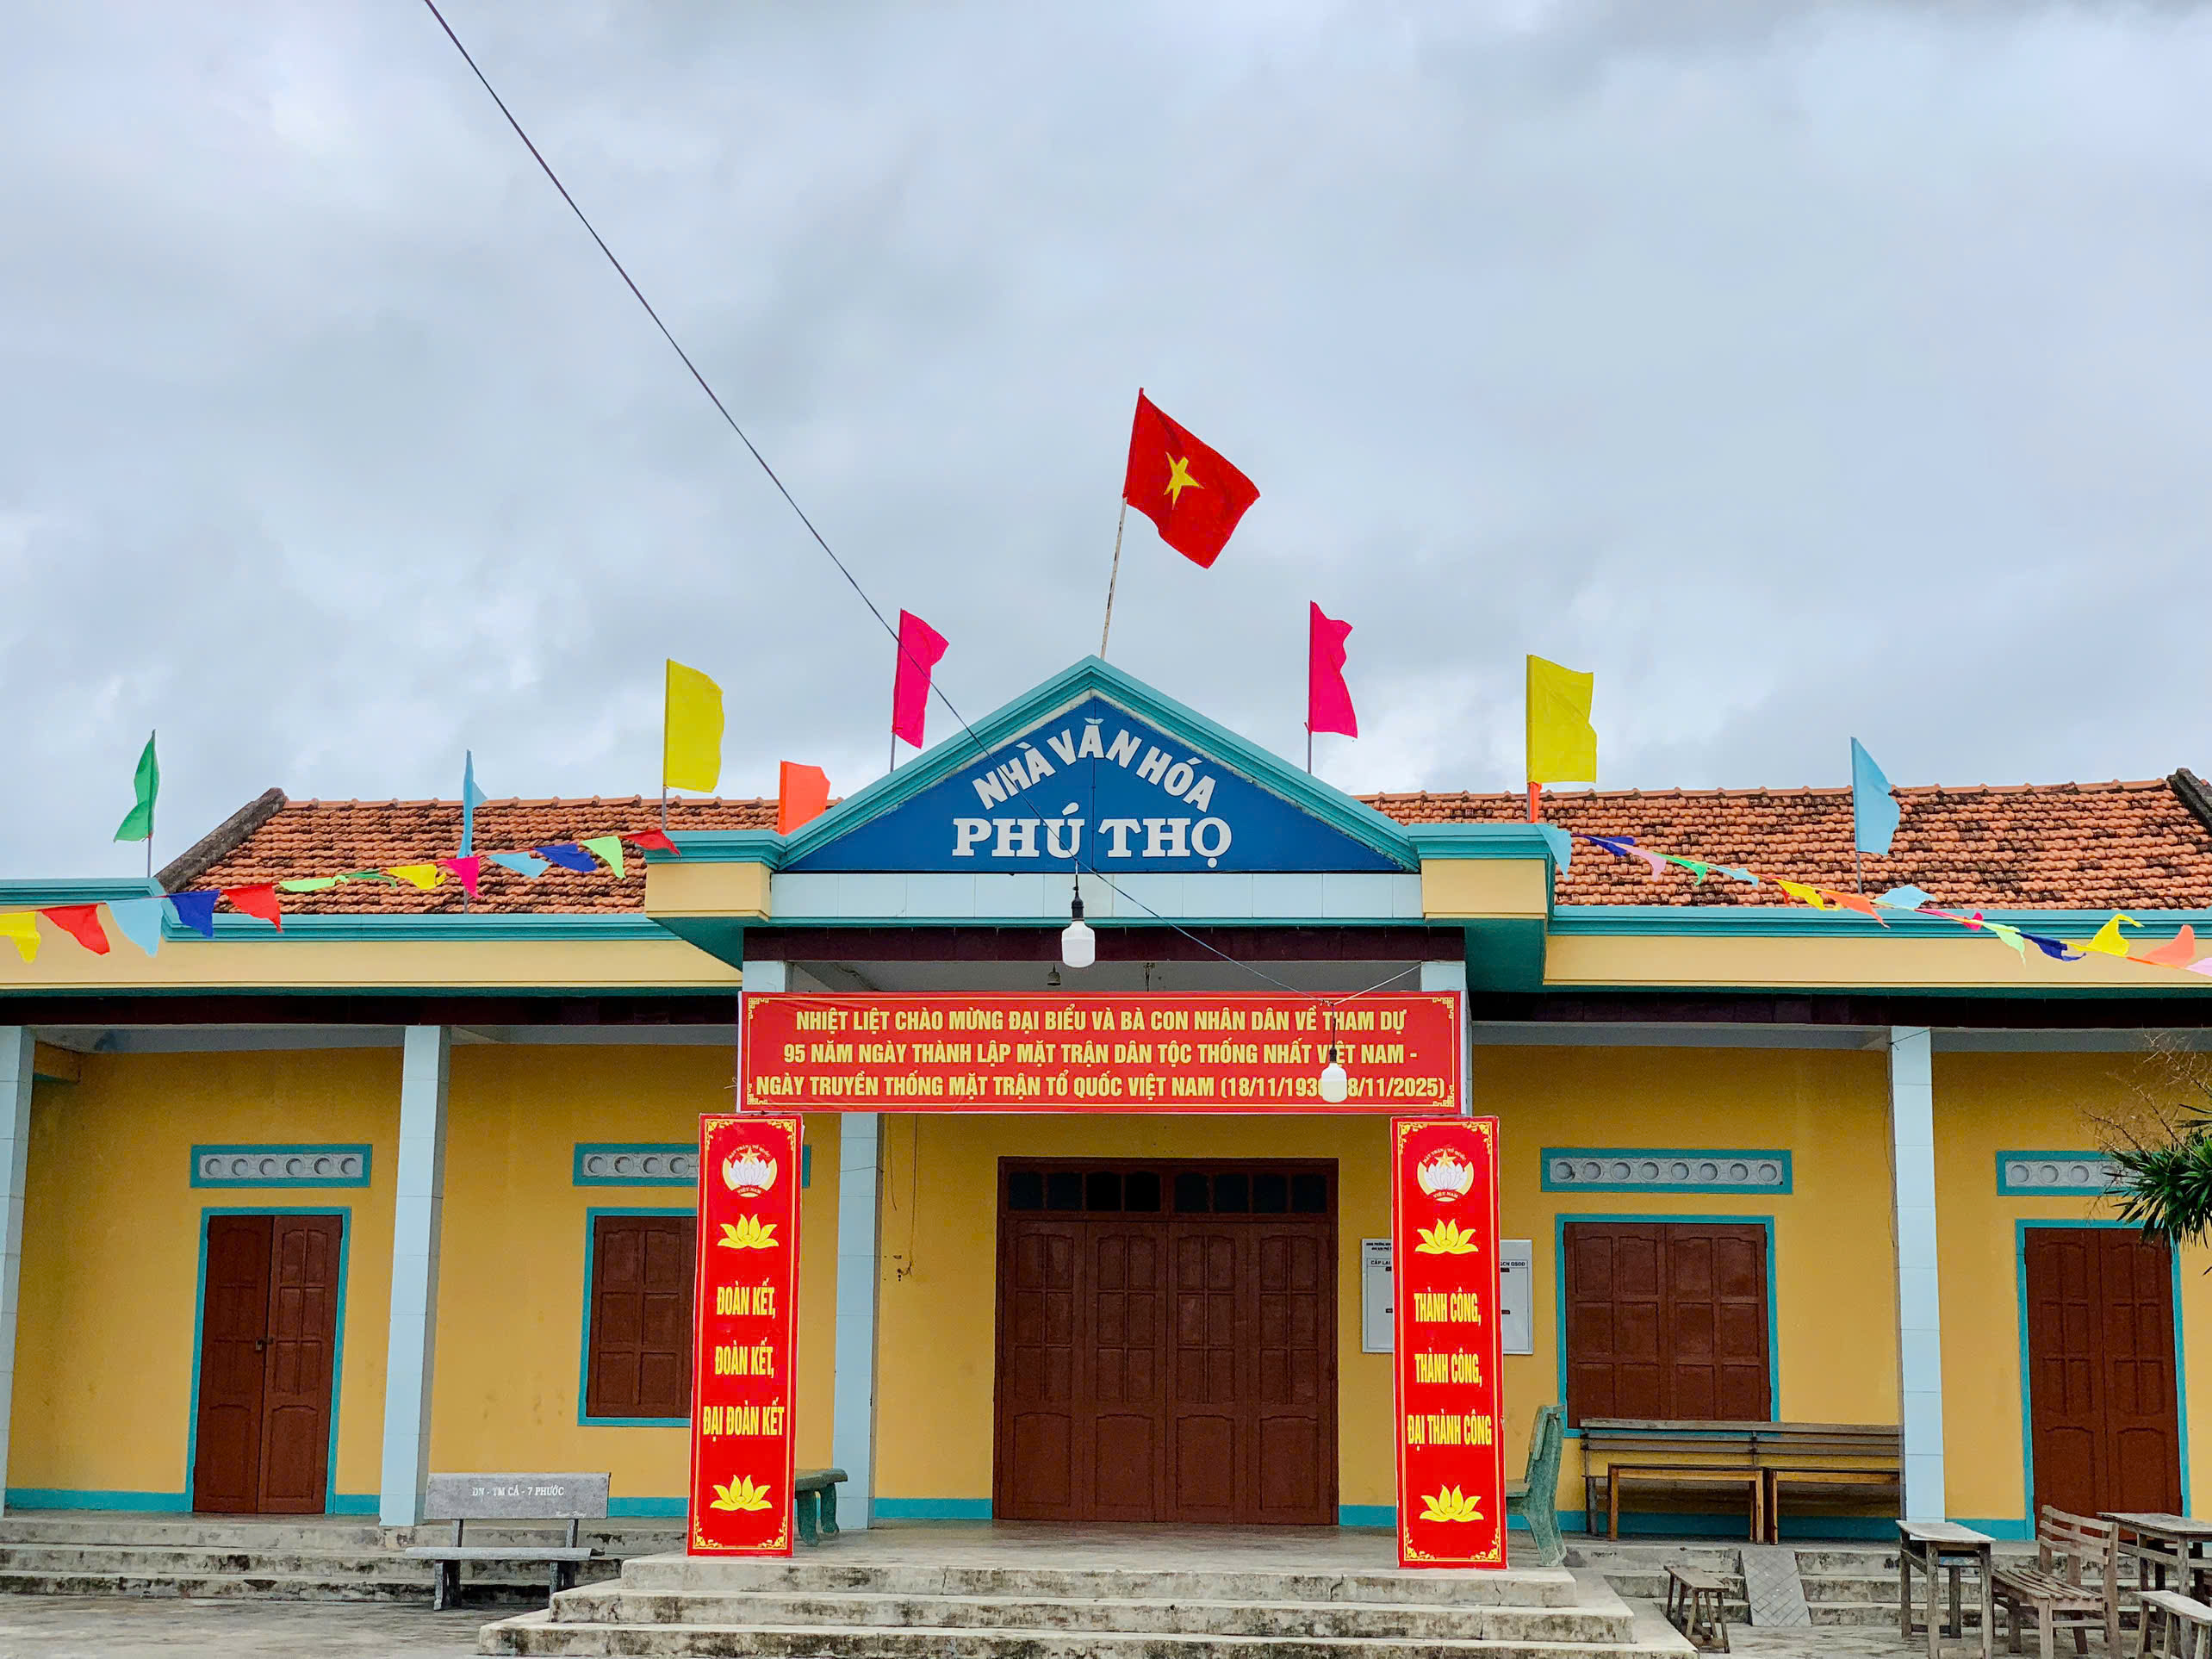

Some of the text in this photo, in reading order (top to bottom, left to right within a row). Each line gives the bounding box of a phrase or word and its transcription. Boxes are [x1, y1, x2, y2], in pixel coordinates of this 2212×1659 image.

[972, 718, 1217, 813] NHÀ VĂN HÓA
[952, 802, 1233, 869] PHÚ THỌ
[797, 1004, 1407, 1035] NHIỆT LIỆT CHÀO MỪNG ĐẠI BIỂU VÀ BÀ CON NHÂN DÂN VỀ THAM DỰ
[785, 1043, 805, 1063] 95
[811, 1040, 853, 1063] NĂM
[859, 1040, 906, 1063] NGÀY
[912, 1040, 971, 1063] THÀNH
[978, 1040, 1010, 1067] LẬP
[1017, 1040, 1056, 1067] MẶT
[1061, 1040, 1109, 1067] TRẬN
[1115, 1040, 1152, 1064] DÂN
[1158, 1040, 1191, 1067] TỘC
[1197, 1037, 1258, 1064] THỐNG
[1264, 1038, 1312, 1064] NHẤT
[1362, 1044, 1404, 1064] NAM
[756, 1072, 804, 1096] NGÀY
[810, 1071, 878, 1096] TRUYỀN
[884, 1070, 942, 1096] THỐNG
[949, 1072, 988, 1100] MẶT
[993, 1072, 1041, 1100] TRẬN
[1046, 1070, 1068, 1096] TỔ
[1074, 1071, 1122, 1097] QUỐC
[1128, 1072, 1166, 1100] VIỆT
[1171, 1077, 1214, 1097] NAM
[717, 1277, 775, 1319] ĐOÀN KẾT,
[1414, 1287, 1481, 1326] THÀNH CÔNG,
[715, 1337, 774, 1378] ĐOÀN KẾT,
[1414, 1347, 1482, 1387] THÀNH CÔNG,
[703, 1397, 785, 1442] ĐẠI ĐOÀN KẾT
[1407, 1408, 1492, 1451] ĐẠI THÀNH CÔNG
[527, 1487, 533, 1496] 7
[535, 1484, 564, 1496] PHƯỚC
